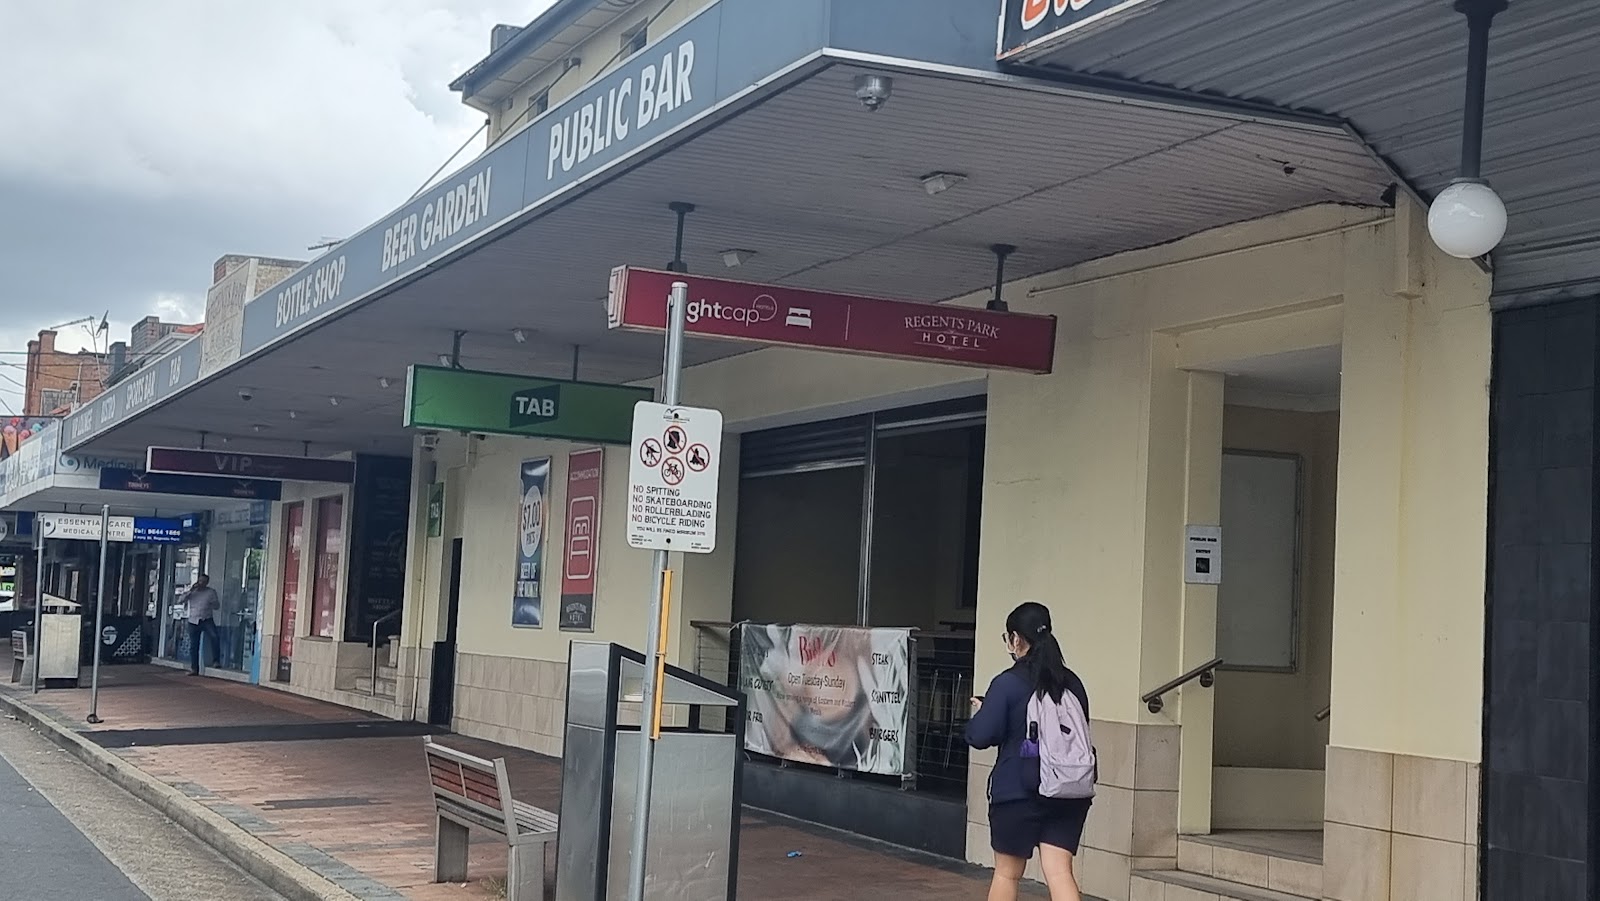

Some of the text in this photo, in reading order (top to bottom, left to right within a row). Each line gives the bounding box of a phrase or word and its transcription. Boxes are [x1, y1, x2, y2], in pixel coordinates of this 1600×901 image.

[547, 39, 695, 180] PUBLIC BAR
[382, 166, 492, 272] BEER GARDEN
[275, 273, 313, 329] BOTTLE
[313, 255, 346, 309] SHOP
[686, 298, 760, 328] ghtcap
[904, 315, 1001, 339] REGENTS PARK
[922, 332, 980, 348] HOTEL
[168, 355, 182, 388] TAB
[515, 396, 555, 417] TAB
[215, 454, 253, 472] VIP
[633, 484, 680, 497] NO SPITTING
[632, 504, 711, 519] NO ROLLERBLADING
[633, 494, 712, 510] NO SKATEBOARDING
[58, 518, 132, 528] ESSENTIA CARE
[522, 500, 541, 533] $7.00
[631, 514, 705, 528] NO BICYCLE RIDING
[63, 528, 126, 537] MEDICAL CNTRE
[871, 652, 889, 666] STEAK
[787, 672, 846, 692] Open Tuesday-Sunday
